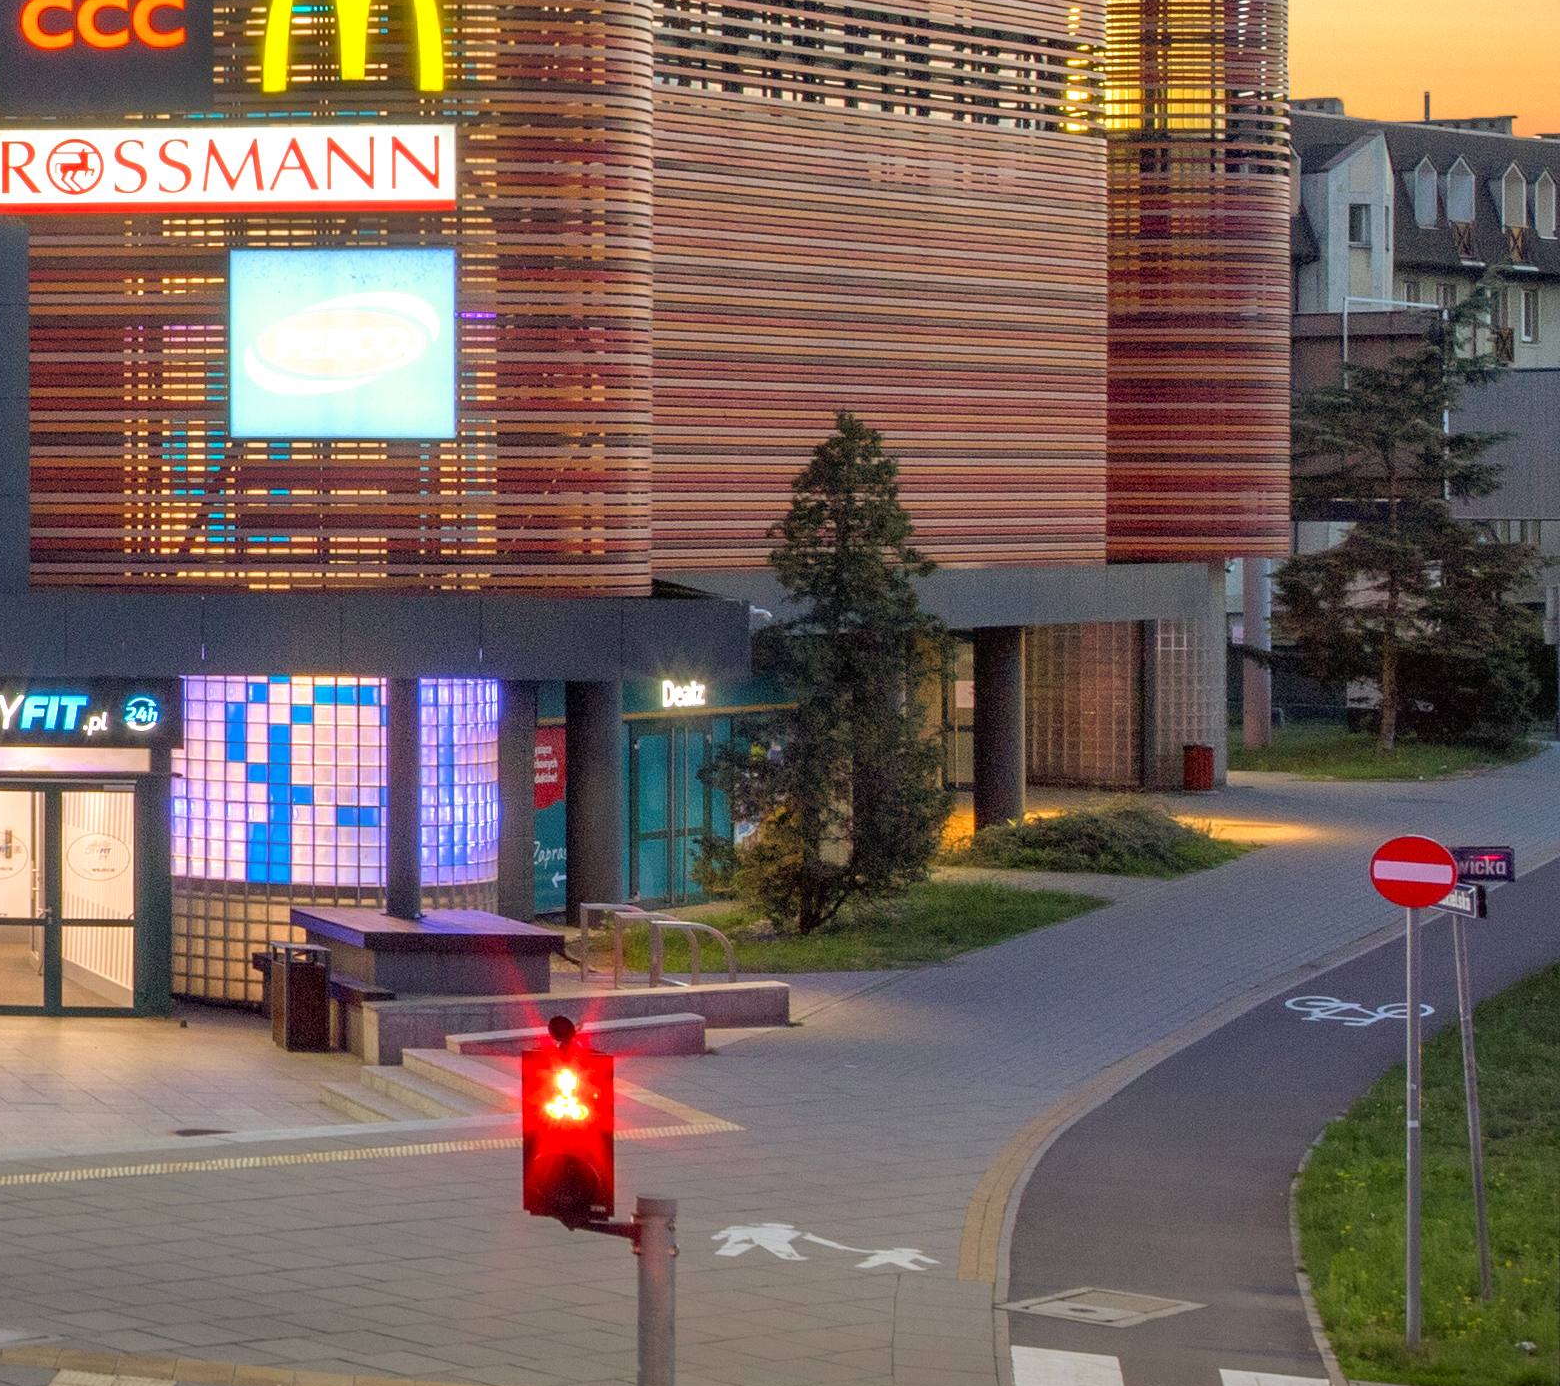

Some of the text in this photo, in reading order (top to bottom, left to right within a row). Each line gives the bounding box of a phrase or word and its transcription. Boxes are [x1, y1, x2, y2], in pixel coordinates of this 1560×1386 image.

[1, 134, 441, 196] ROSSMANN
[661, 680, 706, 707] Dealz
[124, 707, 158, 723] 24h
